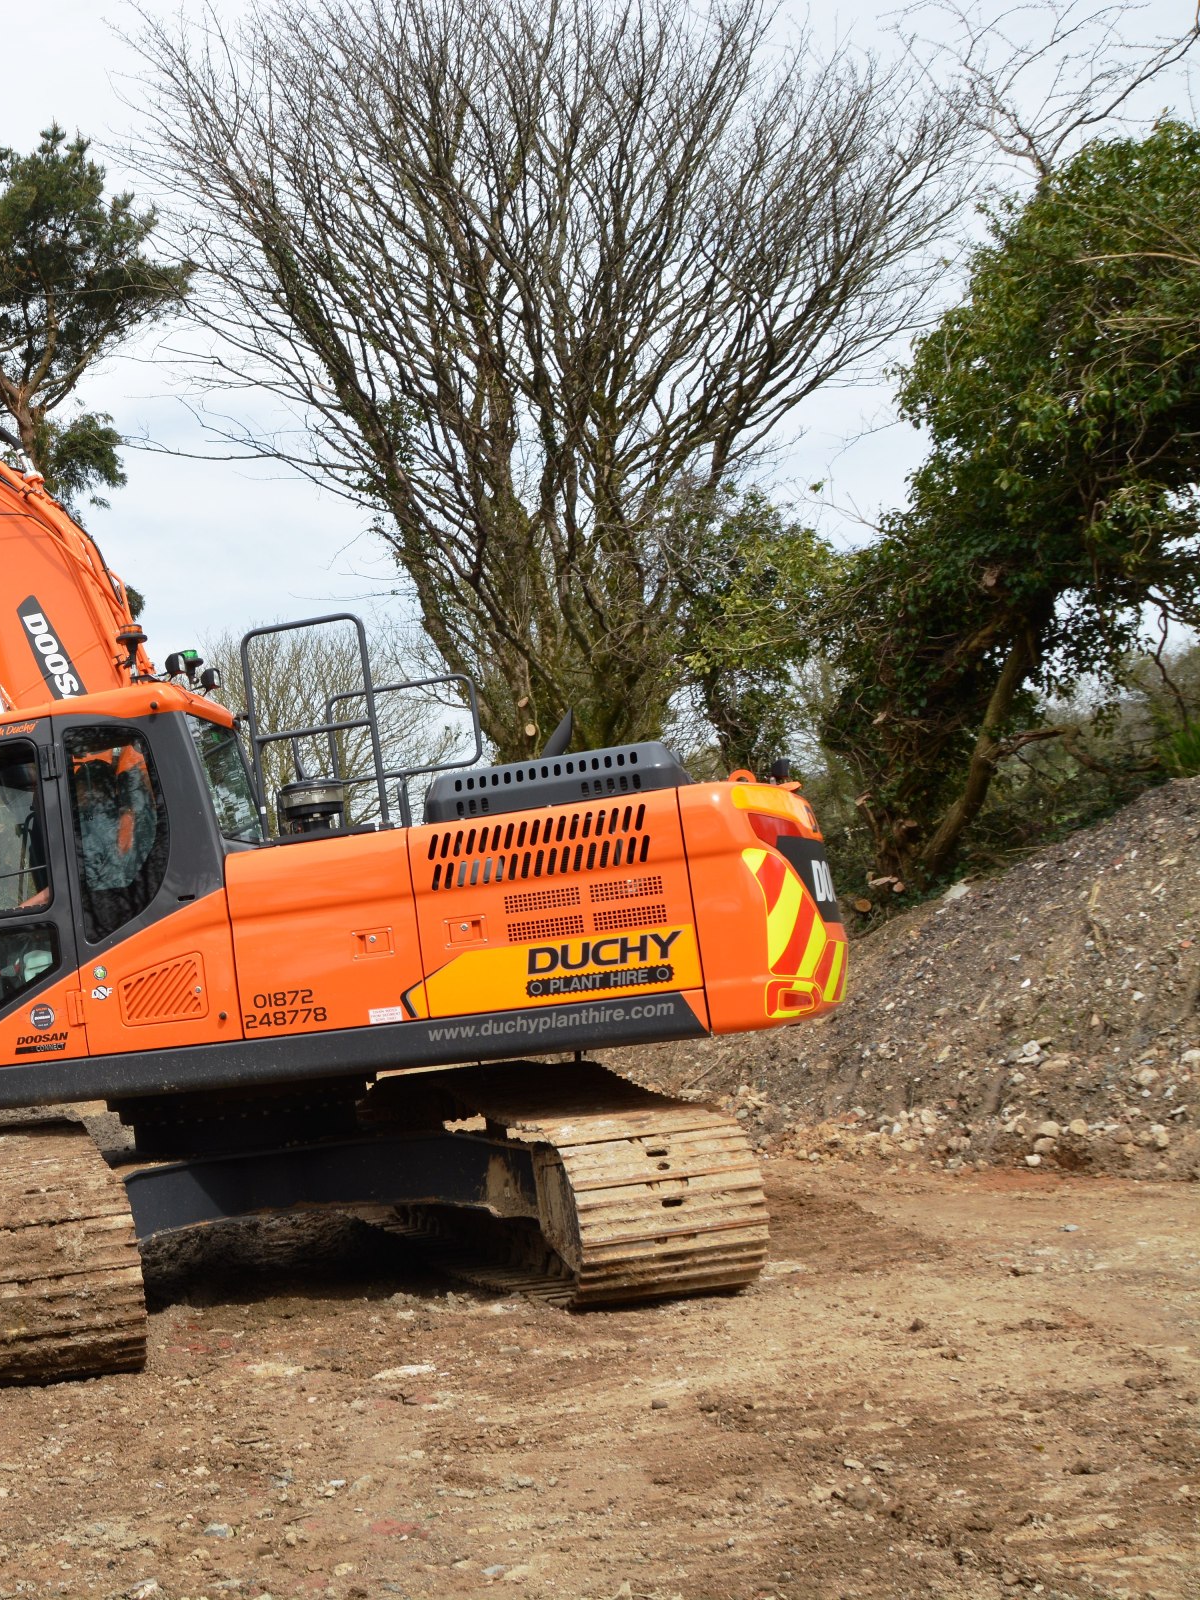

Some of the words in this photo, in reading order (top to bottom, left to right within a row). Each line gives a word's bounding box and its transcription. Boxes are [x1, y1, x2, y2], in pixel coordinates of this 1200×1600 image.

[22, 612, 81, 699] DOOS
[811, 859, 837, 903] DO
[527, 930, 683, 975] DUCHY
[549, 974, 604, 993] PLANT
[609, 968, 649, 987] HIRE
[253, 989, 314, 1009] 01872
[245, 1007, 327, 1030] 248778
[428, 1001, 675, 1042] www.duchyplanthire.com
[17, 1032, 68, 1045] DOOSAN
[36, 1042, 65, 1052] CONNECT
